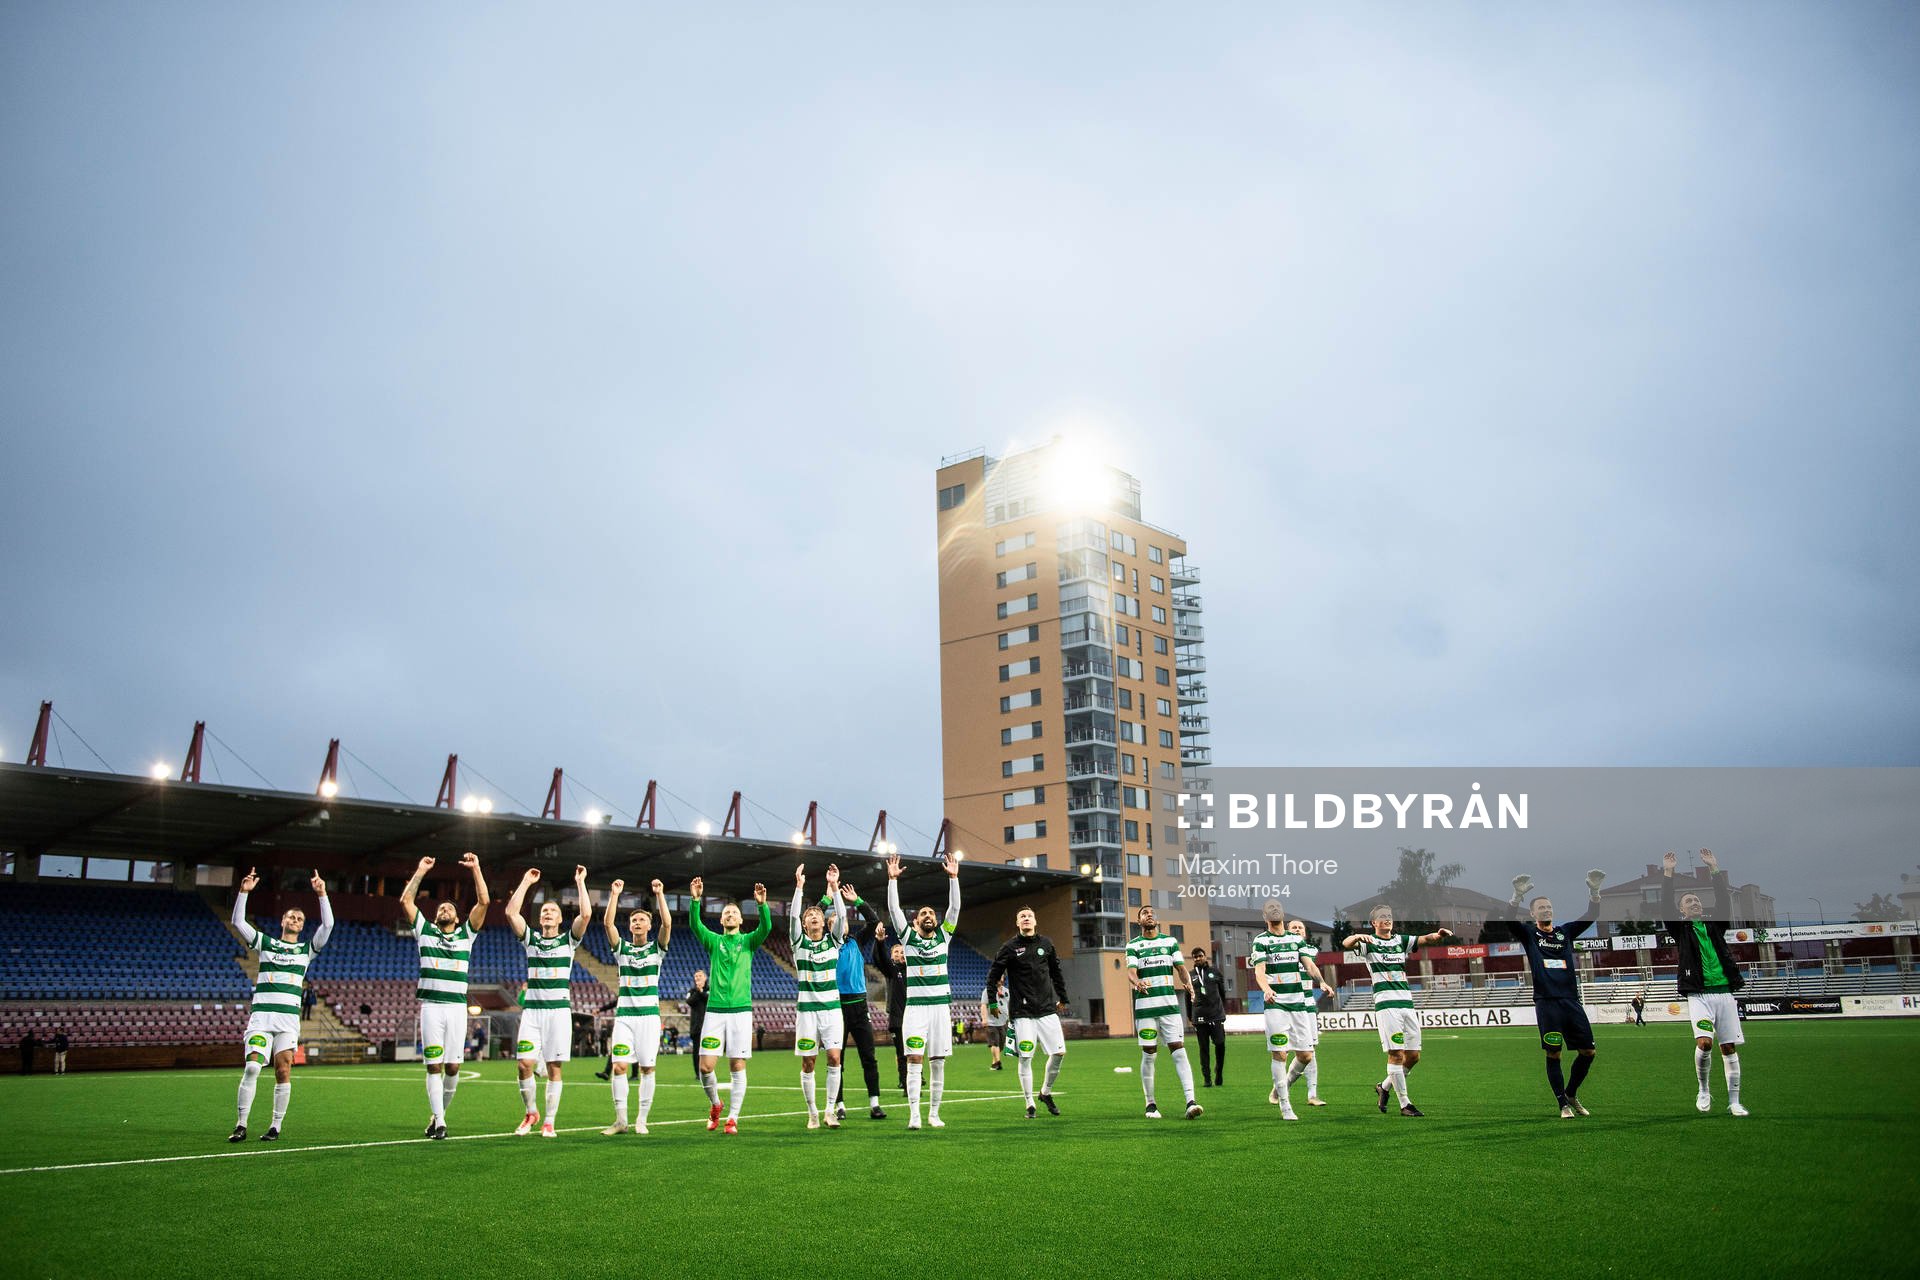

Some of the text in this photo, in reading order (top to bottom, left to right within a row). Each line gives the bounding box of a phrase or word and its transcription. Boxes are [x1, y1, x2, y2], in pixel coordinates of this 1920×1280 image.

[1586, 939, 1609, 948] FRONT
[1621, 936, 1646, 944] SMART
[1745, 1003, 1772, 1012] PUMA
[1486, 1008, 1512, 1025] AB
